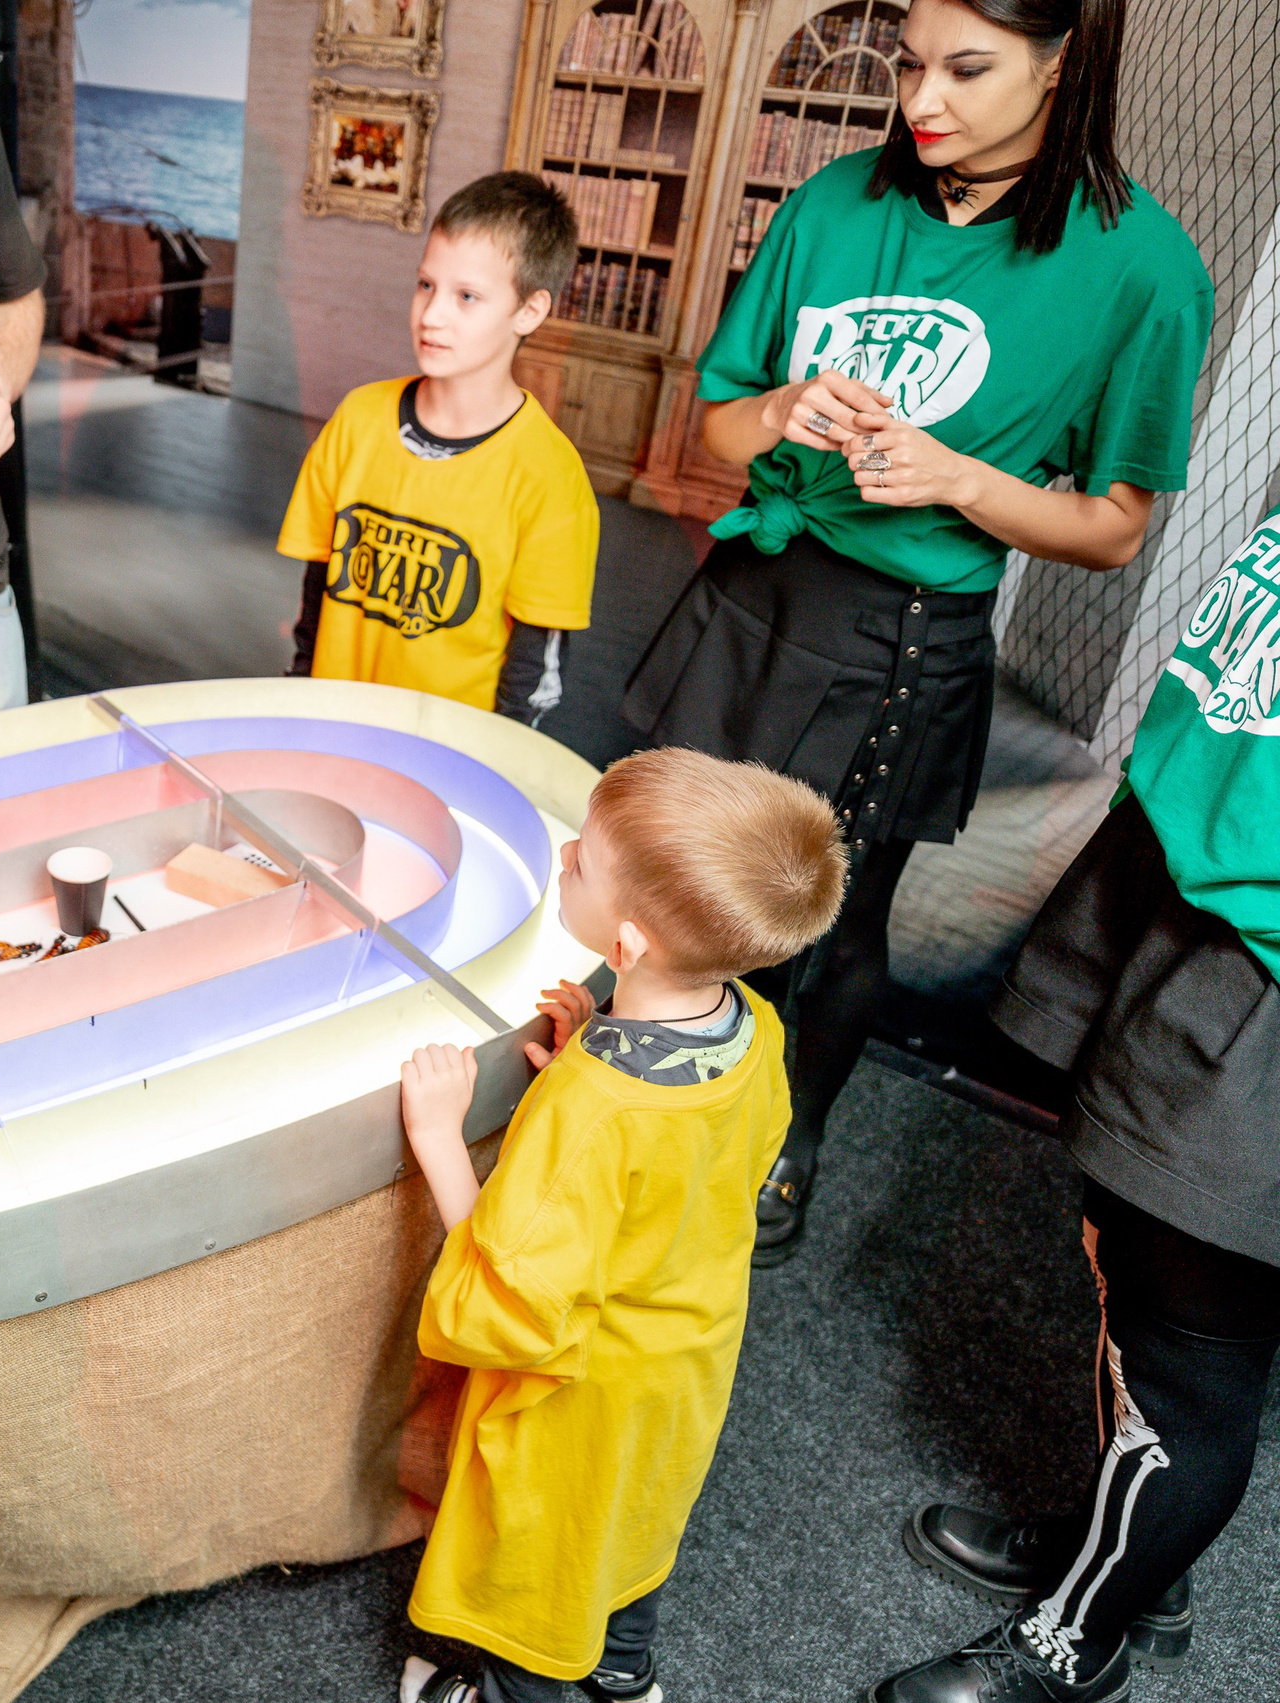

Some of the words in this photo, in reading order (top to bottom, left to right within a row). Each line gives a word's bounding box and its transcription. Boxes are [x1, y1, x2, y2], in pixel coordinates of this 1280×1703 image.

[365, 518, 431, 556] FORT
[1236, 534, 1280, 586] FO
[1204, 691, 1247, 725] 2.0
